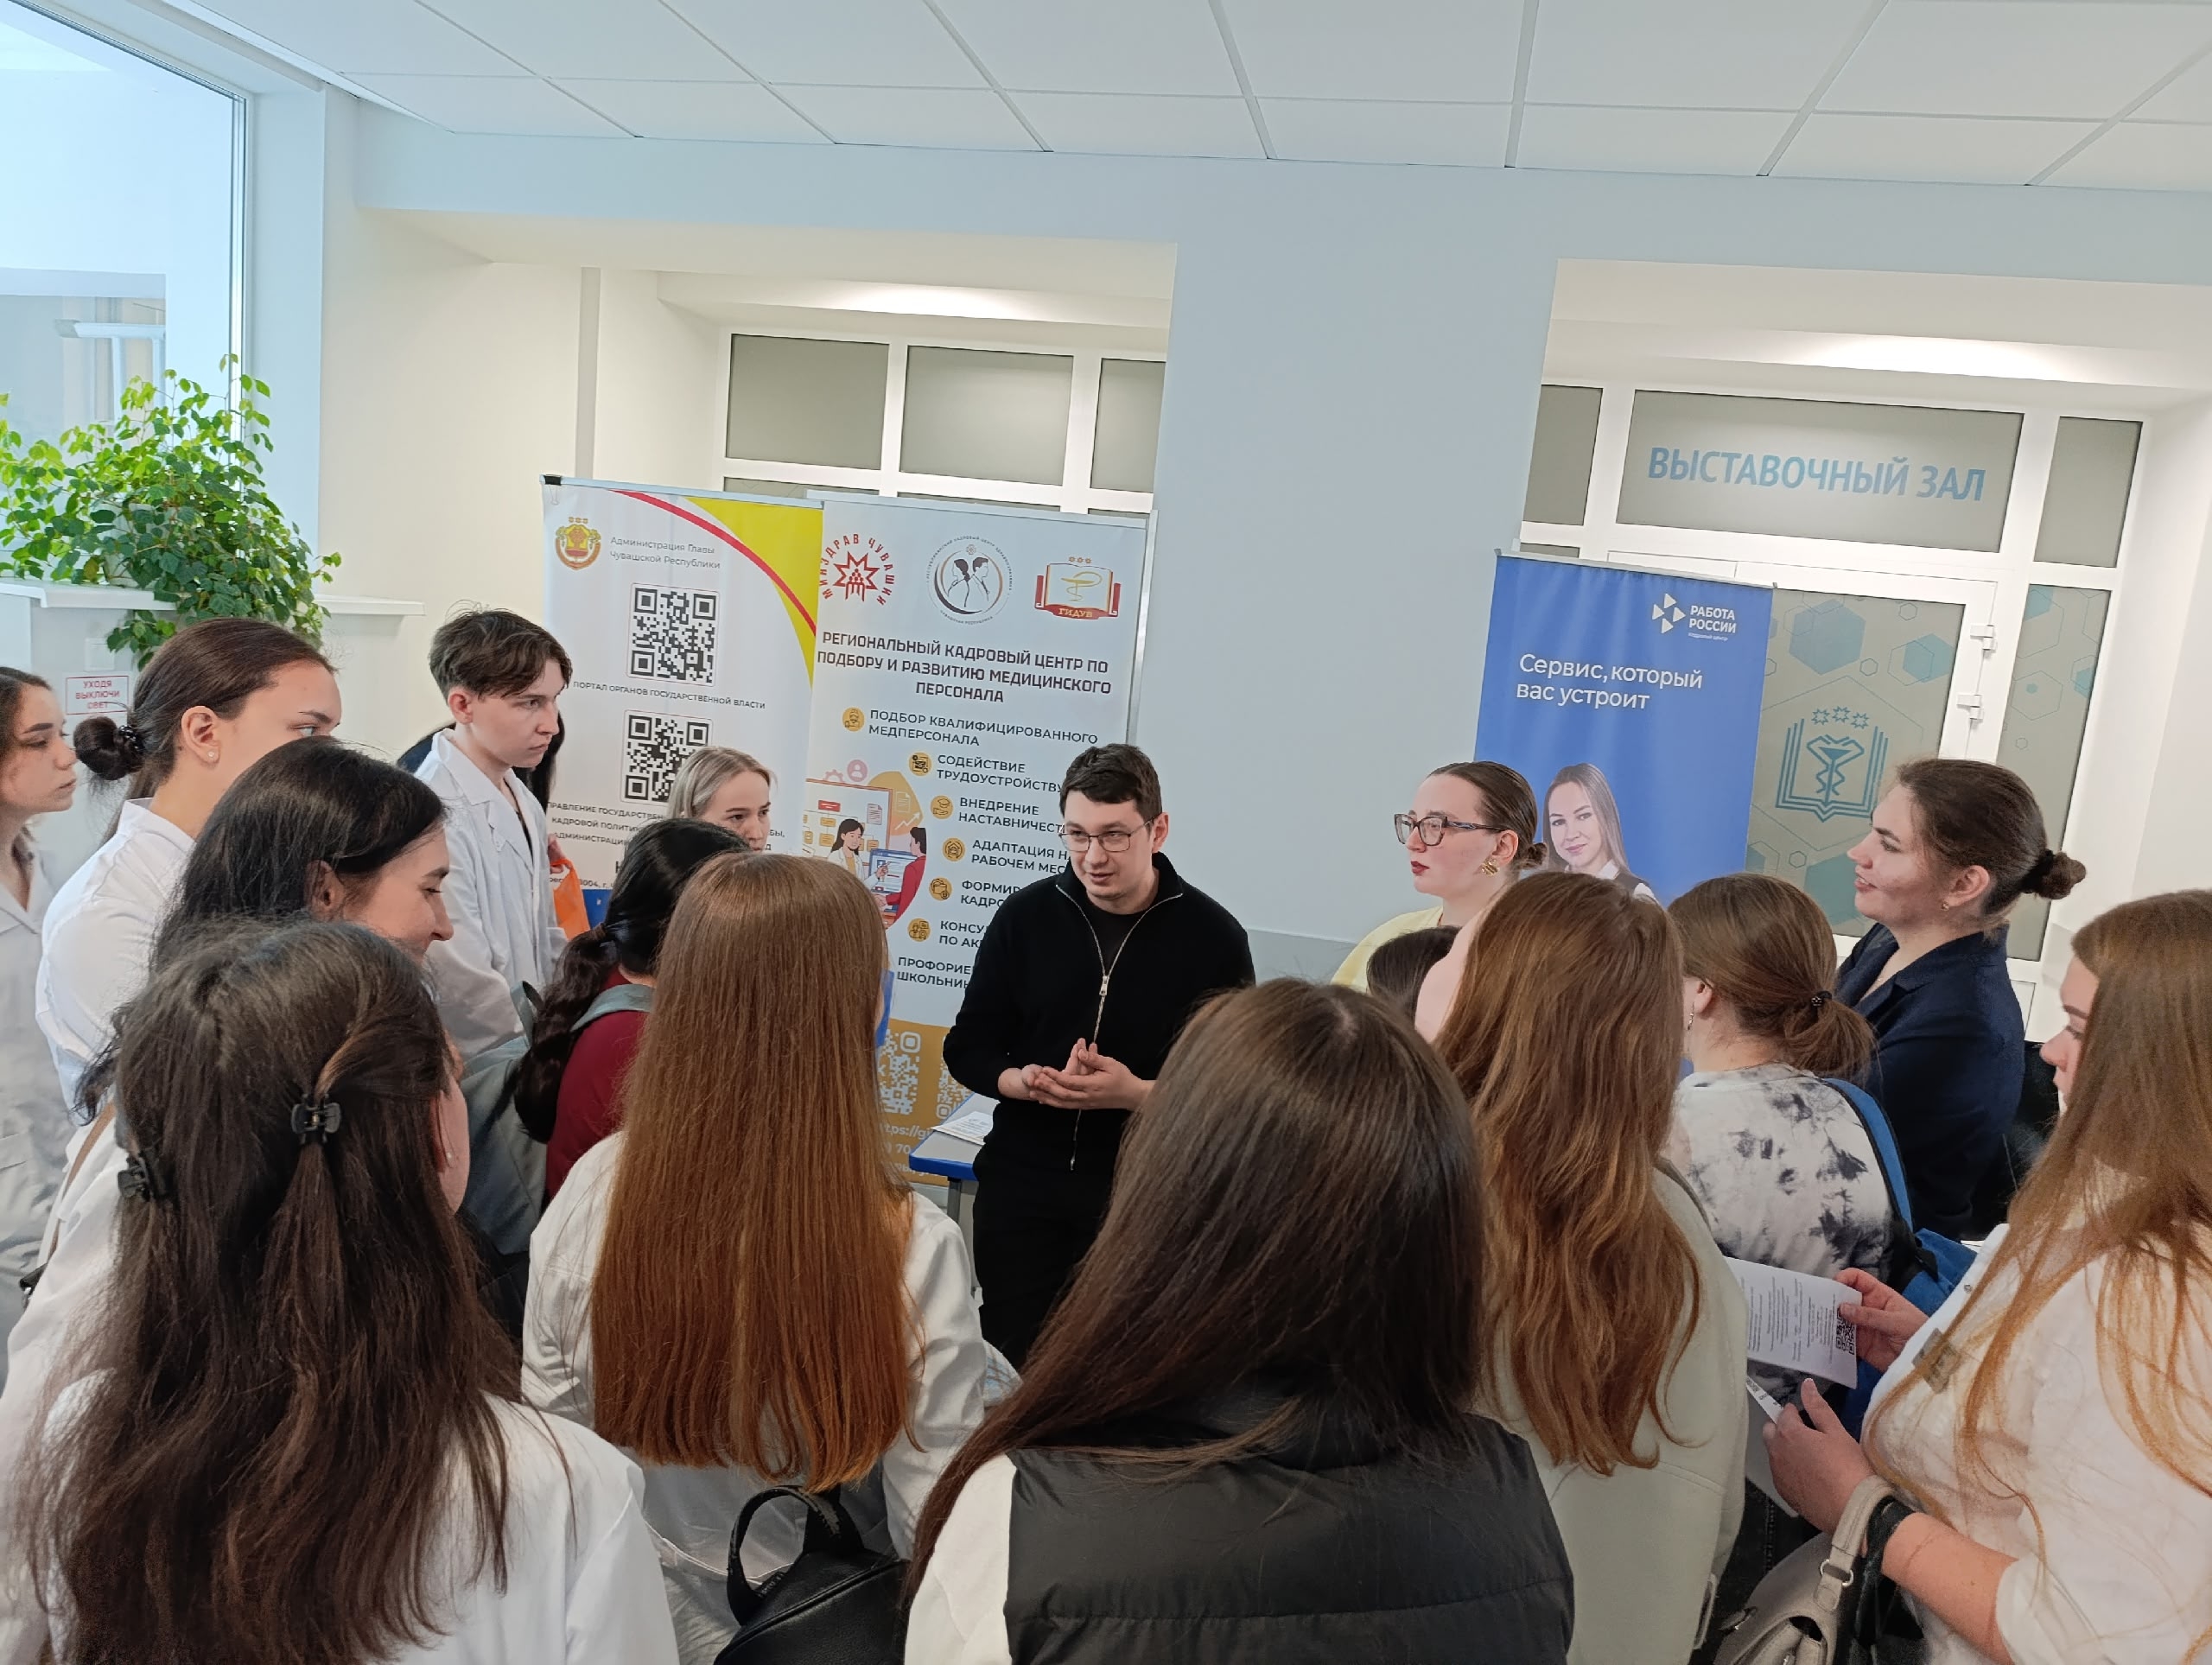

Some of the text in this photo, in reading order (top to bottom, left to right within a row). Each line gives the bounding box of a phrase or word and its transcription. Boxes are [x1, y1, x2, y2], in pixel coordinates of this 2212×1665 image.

[1648, 446, 1986, 501] ВЫСТАВОЧНЫЙ ЗАЛ
[610, 537, 715, 555] Администрация Главы
[610, 550, 721, 569] Чувашской Республики
[868, 537, 895, 605] ЧУВАШИИ
[1058, 607, 1093, 619] ГИДУВ
[1690, 605, 1735, 620] РАБОТА
[1689, 618, 1737, 633] РОССИИ
[823, 632, 1109, 674] РЕГИОНАЛЬНЫЙ КАДРОВЫЙ ЦЕНТР ПО
[817, 651, 1111, 695] ПОДБОРУ И РАЗВИТИЮ МЕДИЦИНСКОГО
[1519, 652, 1703, 690] Сервис, который
[83, 680, 112, 689] УХОДЯ
[916, 682, 1004, 703] ПЕРСОНАЛА
[573, 681, 766, 709] ПОРТАЛ ОРГАНОВ ГОСУДАРСТВЕННОЙ ВЛАСТИ
[1516, 683, 1649, 710] вас устроит
[868, 725, 980, 746] МЕДПЕРСОНАЛА
[870, 709, 1098, 744] ПОДБОР КВАЛИФИЦИРОВАННОГО
[938, 754, 1026, 773] СОДЕЙСТВИЕ
[548, 802, 663, 819] ПРАВЛЕНИЕ ГОСУДАРСТВЕН
[960, 798, 1039, 816] ВНЕДРЕНИЕ
[552, 817, 598, 828] КАДРОВОЙ
[959, 812, 1065, 834] НАСТАВНИЧЕСТ
[555, 832, 629, 845] АДМИНИСТРАЦИ
[972, 840, 1071, 861] АДАПТАЦИЯ Н
[971, 855, 1065, 874] РАБОЧЕМ МЕС
[962, 880, 1020, 894] ФОРМИР
[961, 895, 1004, 908] КАДРО
[940, 920, 985, 934] КОНСУ
[939, 935, 980, 948] ПО АК
[898, 956, 971, 975] ПРОФОРИЕ
